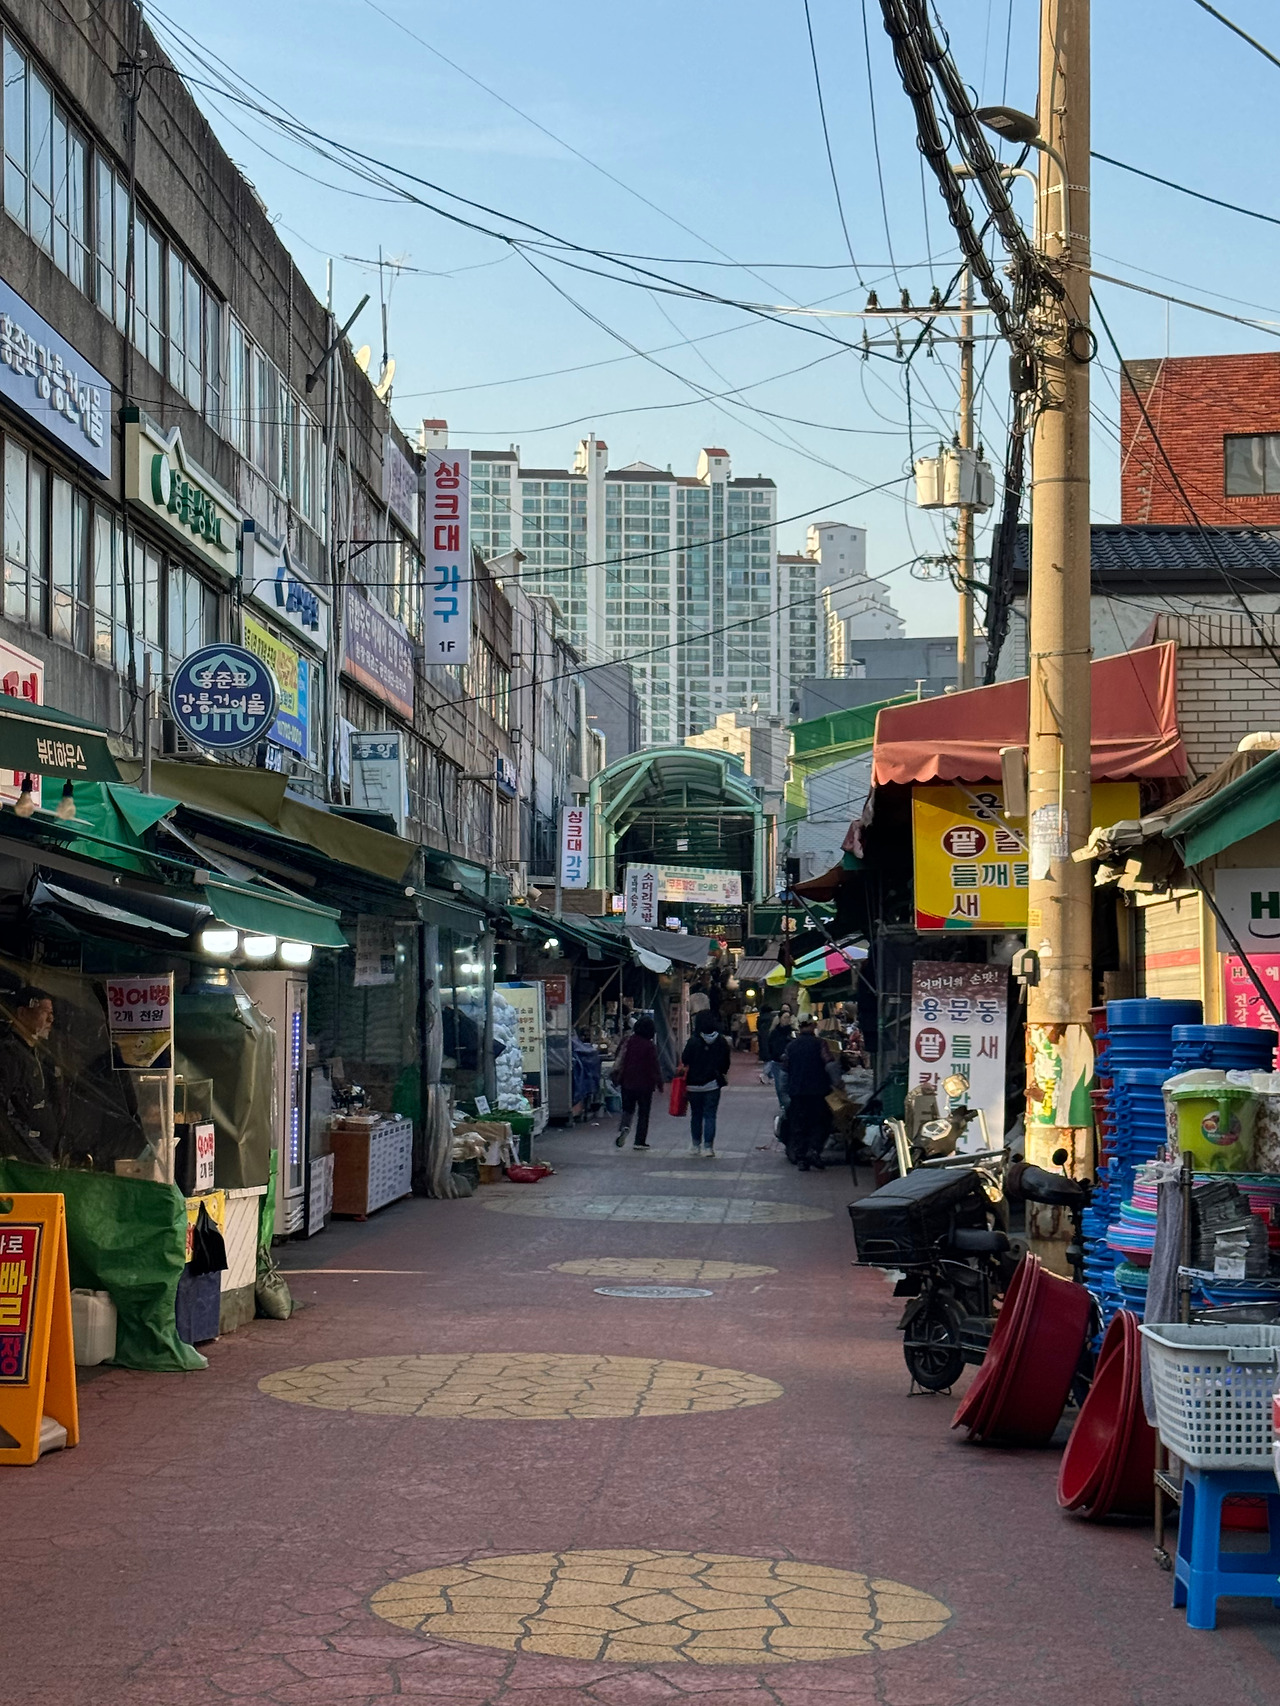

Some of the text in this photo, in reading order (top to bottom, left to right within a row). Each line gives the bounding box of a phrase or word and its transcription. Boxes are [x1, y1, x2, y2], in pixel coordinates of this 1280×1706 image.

[433, 462, 460, 623] 싱크대 가구
[438, 641, 456, 652] 1F
[198, 670, 248, 689] 홍준표
[178, 692, 266, 716] 강릉건어물
[36, 737, 88, 771] 뷰티하우스
[566, 811, 583, 881] 싱크대 가구
[641, 872, 654, 923] 소머리국밥
[920, 972, 998, 990] 어머니의 손맛!
[113, 1010, 134, 1022] 2개
[918, 998, 1000, 1023] 용문동
